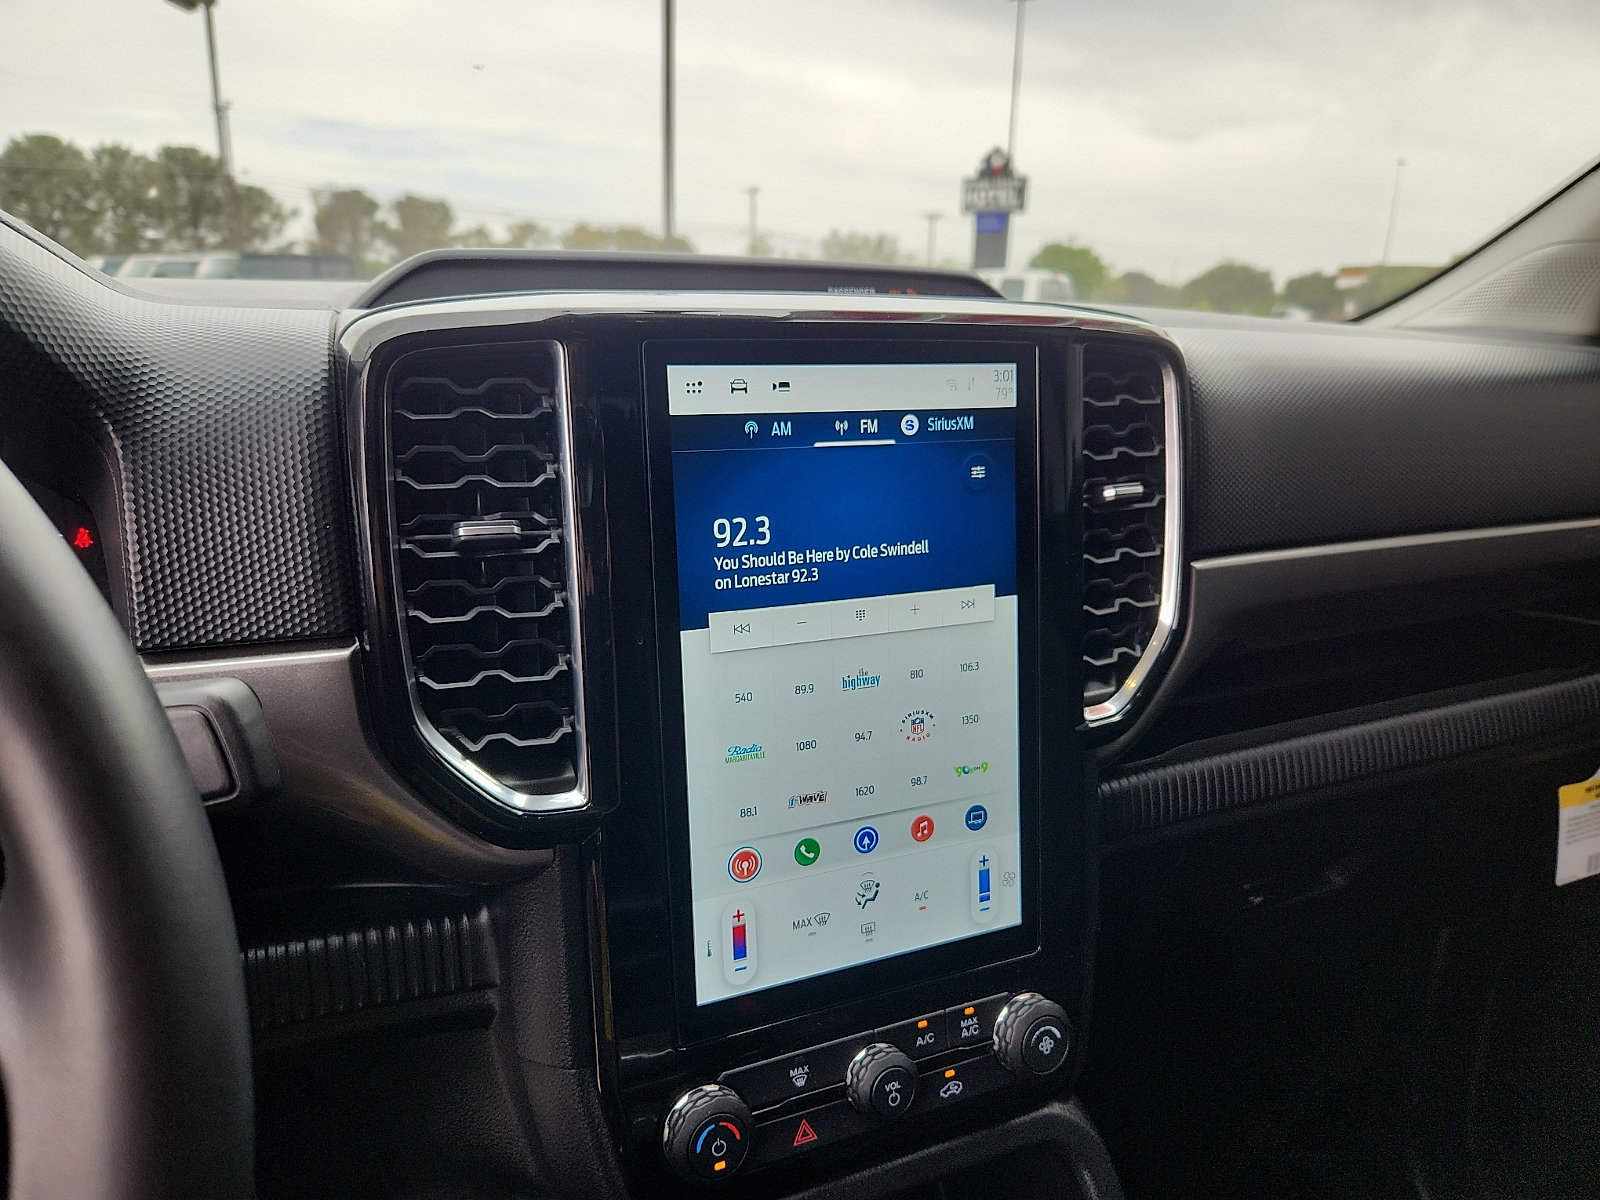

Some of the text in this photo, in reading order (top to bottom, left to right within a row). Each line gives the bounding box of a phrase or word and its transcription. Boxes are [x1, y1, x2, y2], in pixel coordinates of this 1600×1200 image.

[993, 369, 1013, 382] 3:01
[771, 421, 792, 437] AM
[860, 418, 878, 434] FM
[927, 415, 974, 432] SiriusXM
[713, 515, 771, 548] 92.3
[714, 539, 929, 571] You Should Be Here by Cole Swindell
[714, 567, 819, 590] on Lonestar 92.3
[858, 667, 869, 677] the
[959, 660, 980, 673] 106.3
[910, 668, 924, 680] 810
[842, 674, 881, 691] highway
[794, 683, 815, 696] 89.9
[735, 691, 753, 704] 540
[961, 714, 979, 725] 1350
[912, 723, 924, 733] NFL
[854, 731, 873, 742] 94.7
[906, 732, 931, 742] RADIO
[727, 743, 763, 757] Radio
[795, 739, 817, 752] 1080
[910, 775, 928, 787] 98.7
[855, 784, 875, 797] 1620
[740, 806, 757, 819] 88.1
[914, 889, 929, 901] A/C
[792, 917, 813, 930] MAX
[960, 1016, 979, 1029] MAX
[961, 1024, 980, 1038] A/C
[916, 1031, 935, 1047] A/C
[789, 1064, 810, 1078] MAX
[884, 1080, 902, 1093] VOL
